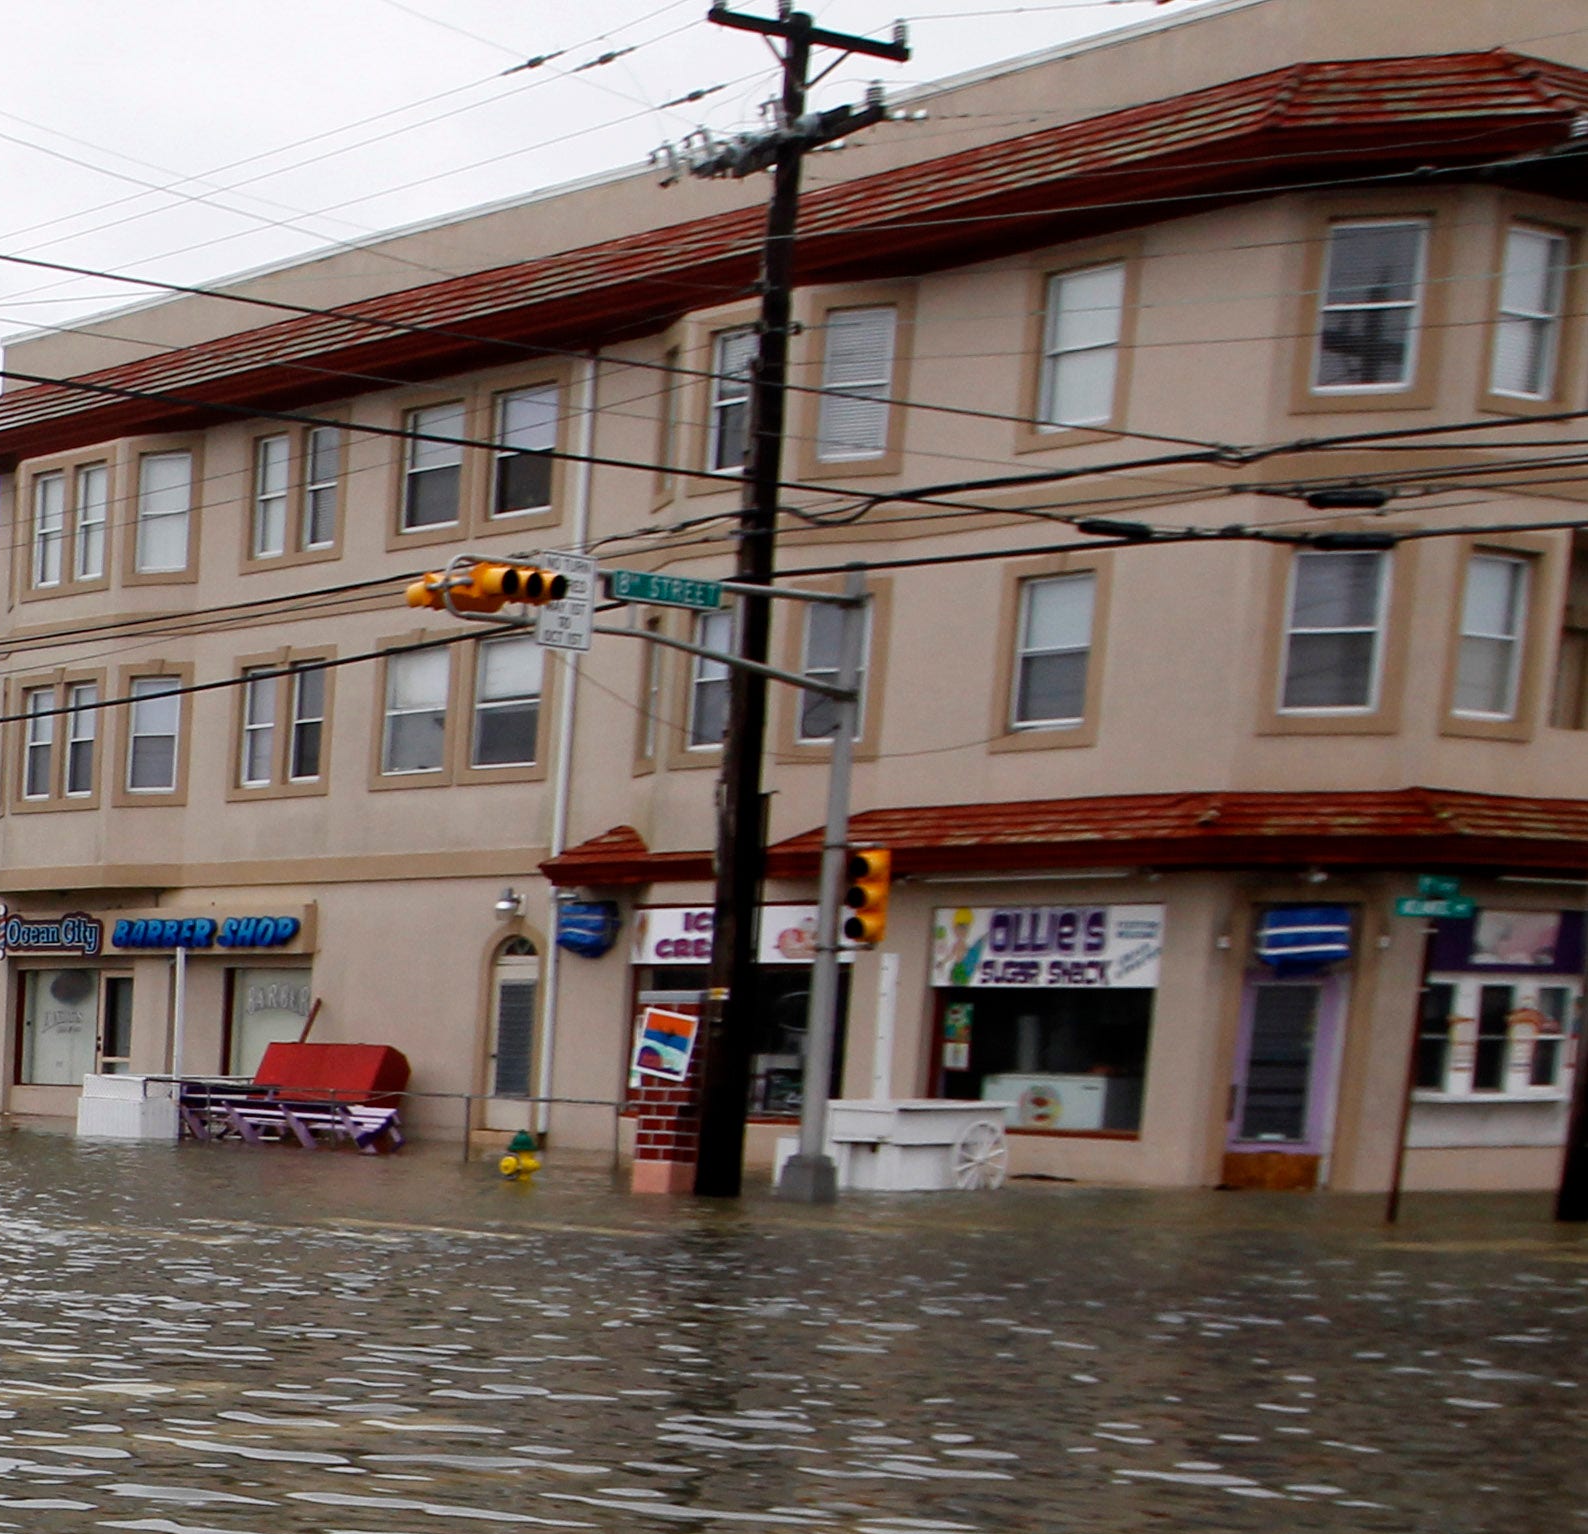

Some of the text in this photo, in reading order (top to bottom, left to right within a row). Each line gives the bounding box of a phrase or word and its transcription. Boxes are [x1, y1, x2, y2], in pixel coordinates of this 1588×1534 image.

[650, 577, 722, 606] STREET
[7, 917, 100, 955] Ocean City
[111, 917, 301, 949] BARBER SHOP
[683, 911, 714, 933] IC
